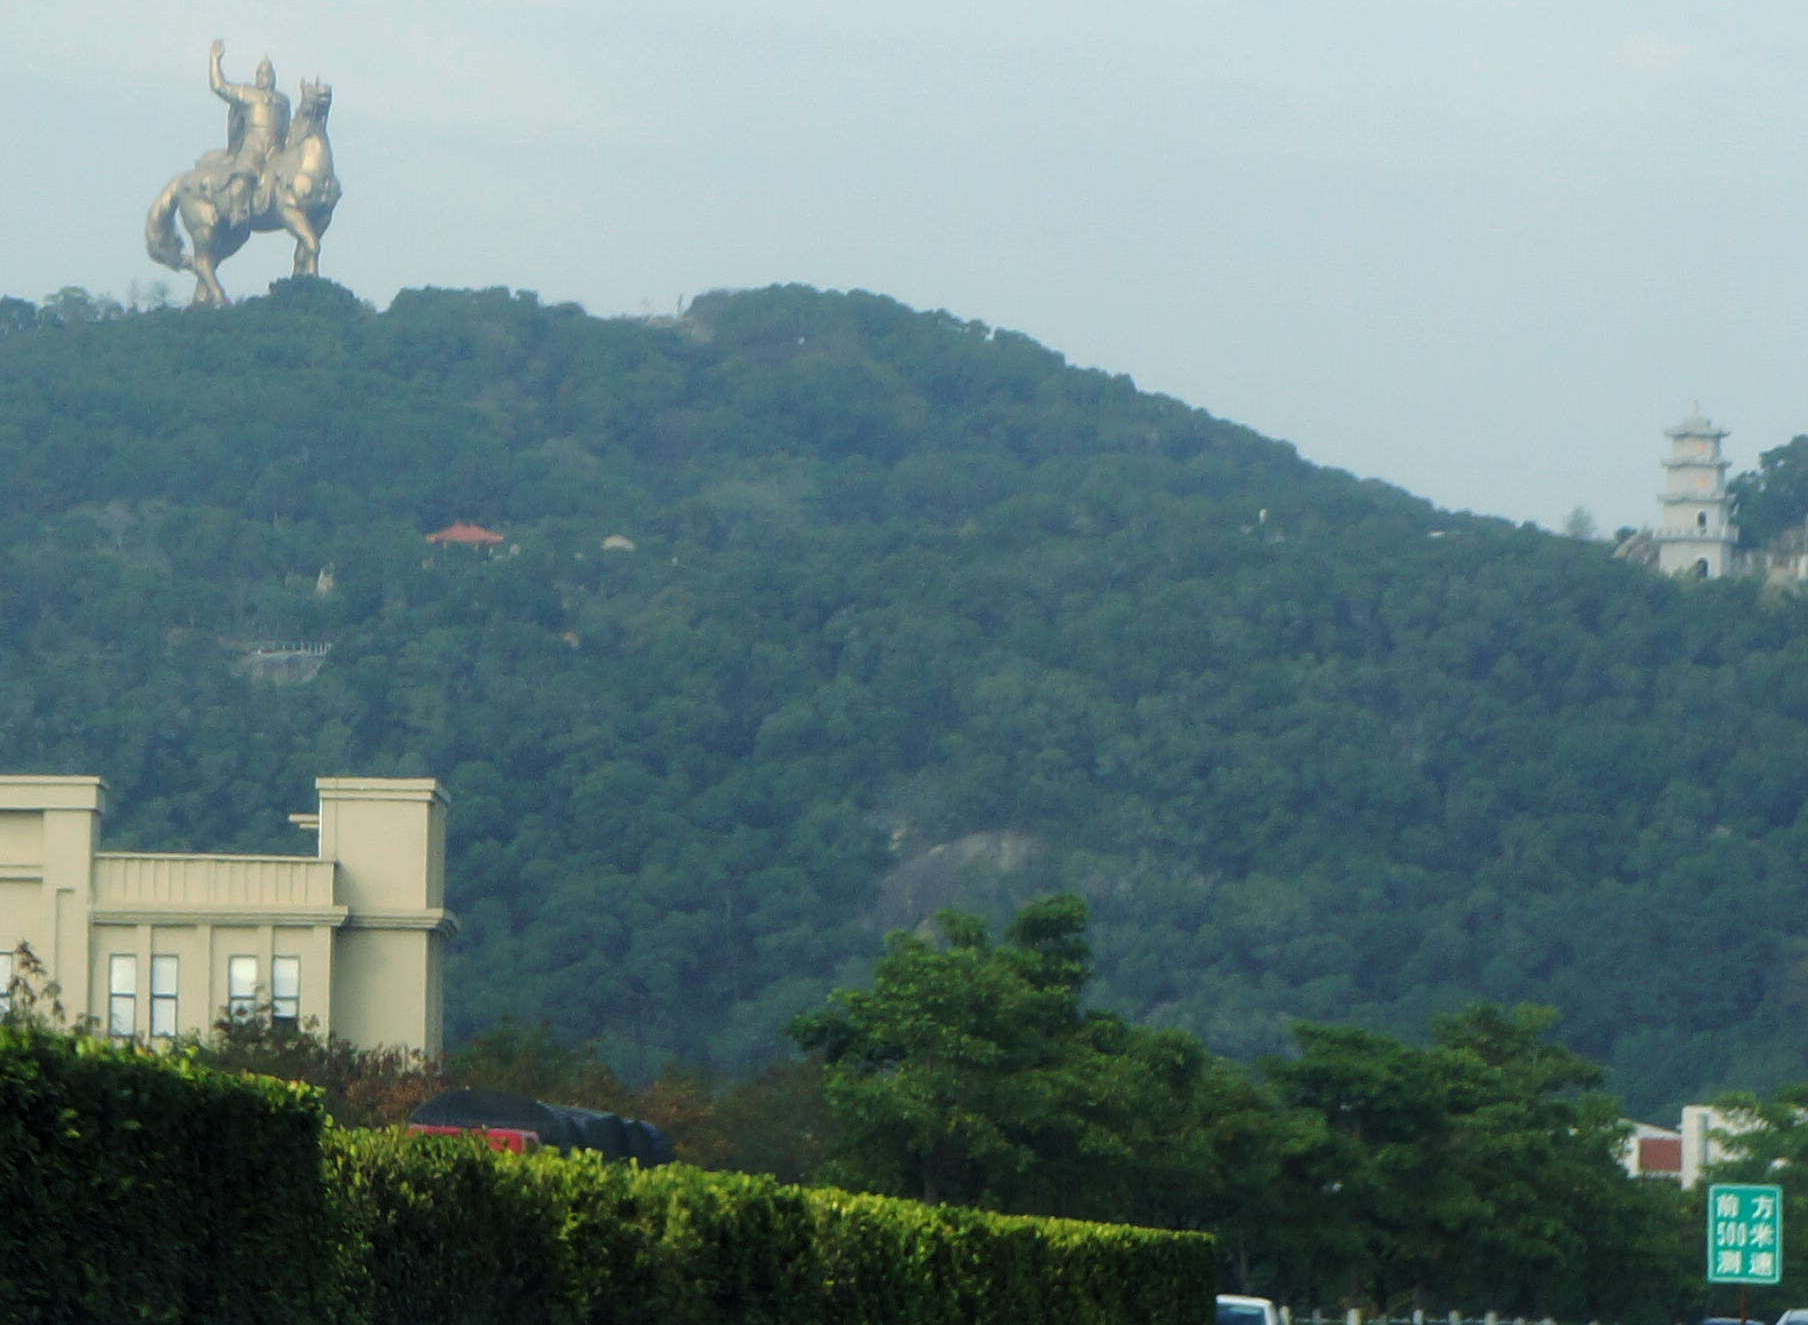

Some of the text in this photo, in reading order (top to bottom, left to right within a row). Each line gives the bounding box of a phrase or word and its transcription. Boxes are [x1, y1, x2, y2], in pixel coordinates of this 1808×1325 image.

[1716, 1194, 1775, 1219] 前方
[1717, 1222, 1774, 1247] 500米
[1717, 1250, 1773, 1275] 测速
